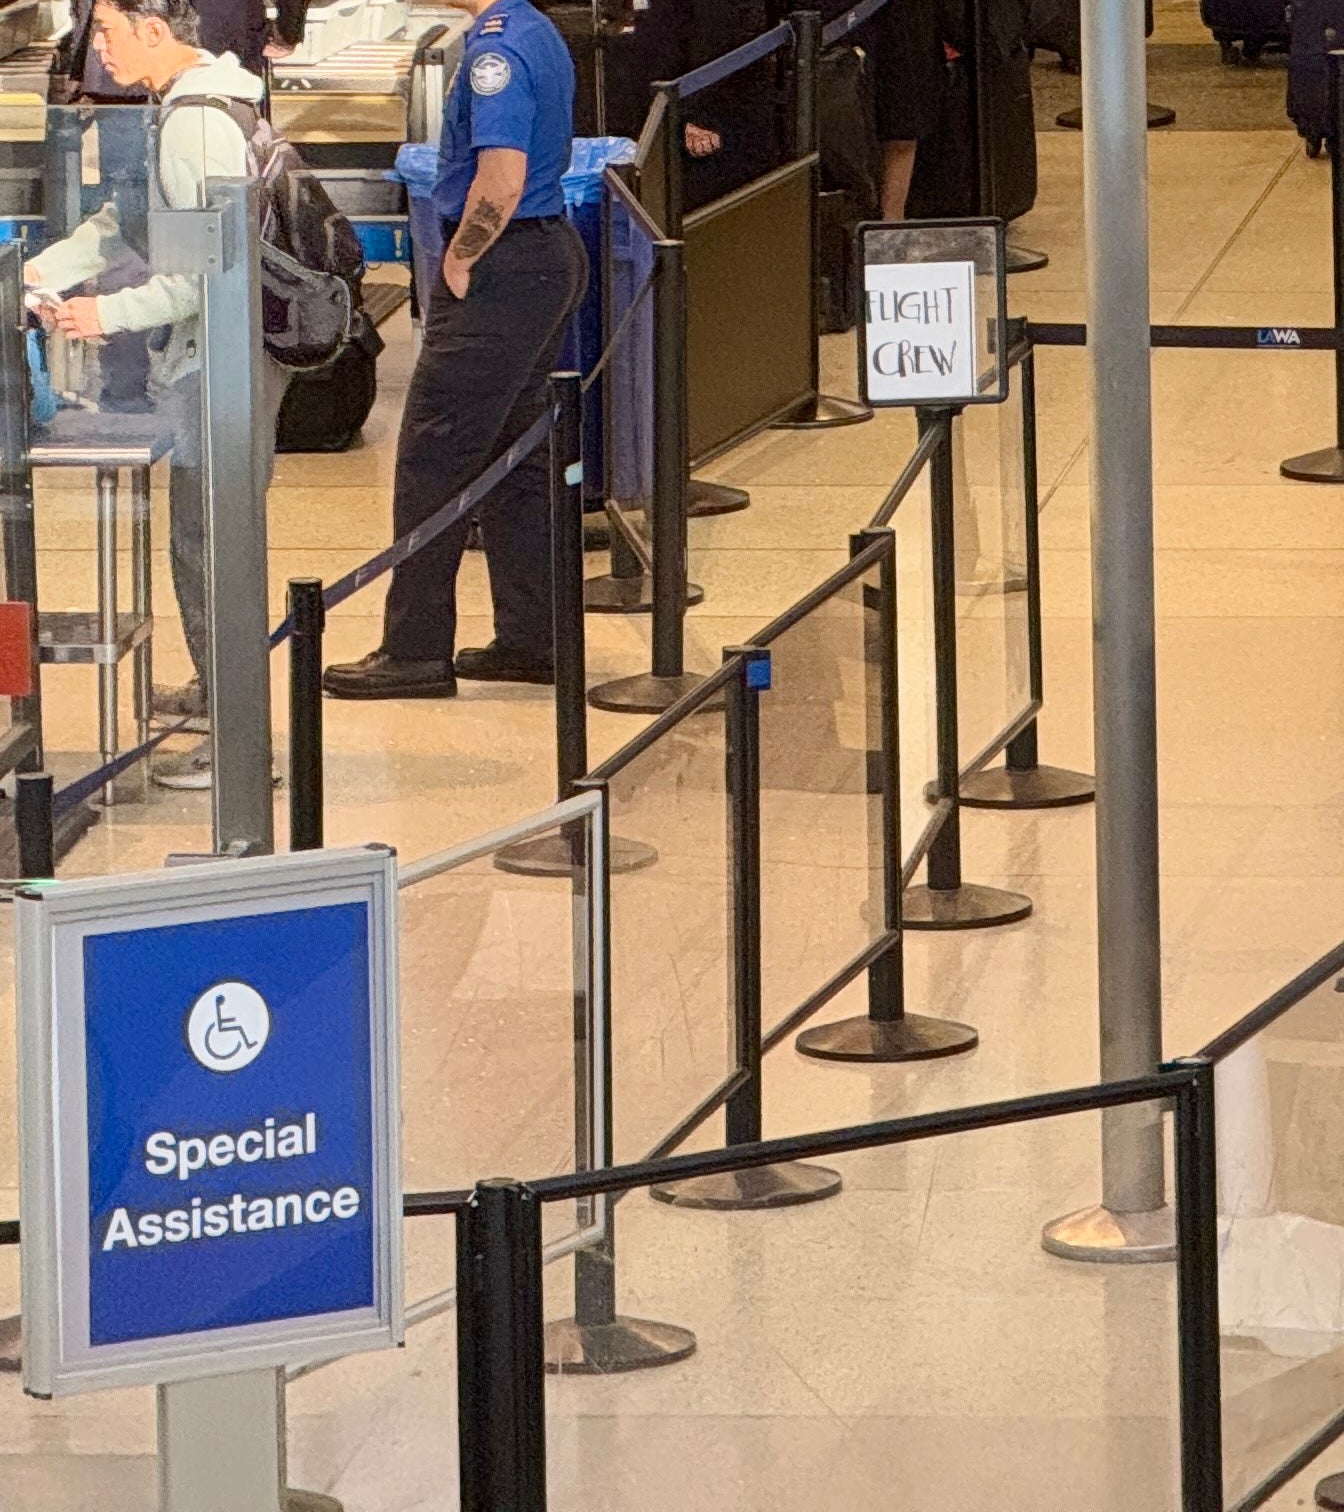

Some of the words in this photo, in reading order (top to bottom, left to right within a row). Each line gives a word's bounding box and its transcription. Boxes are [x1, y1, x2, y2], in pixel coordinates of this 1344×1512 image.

[865, 286, 959, 325] FLIGHT
[1256, 328, 1301, 345] LAWA
[872, 338, 957, 378] CREW
[145, 1112, 316, 1180] Special
[102, 1185, 360, 1251] Assistance
